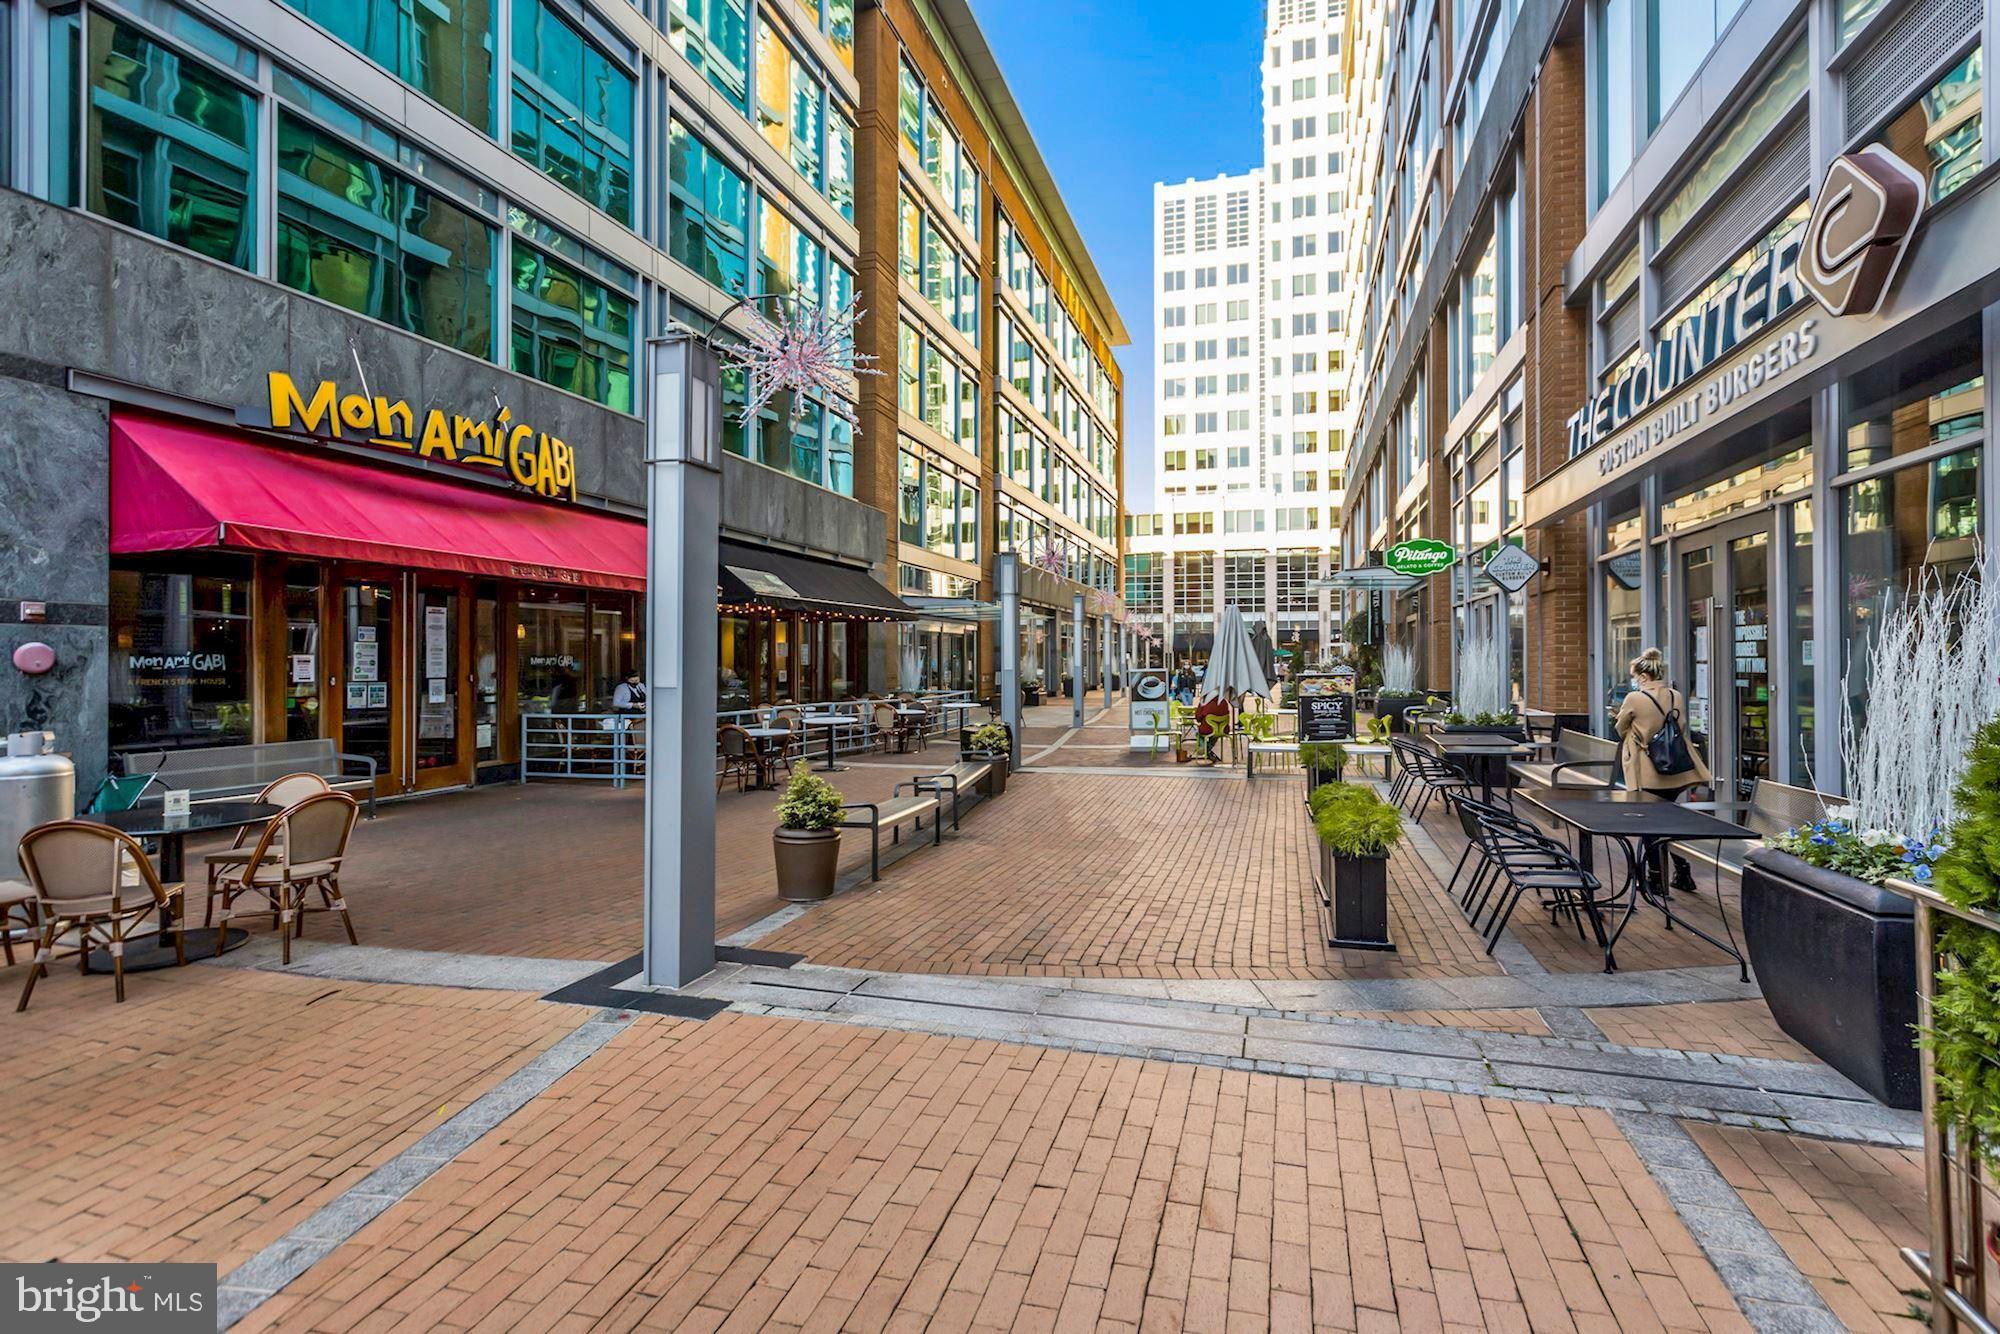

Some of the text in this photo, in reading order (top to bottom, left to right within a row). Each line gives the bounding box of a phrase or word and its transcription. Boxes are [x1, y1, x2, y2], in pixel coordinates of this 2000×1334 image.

[1567, 220, 1811, 460] THE COUNTER
[1599, 319, 1818, 477] CUSTOM BUILT BURGERS
[268, 371, 413, 444] Mon
[506, 423, 577, 503] GABI
[1394, 546, 1448, 563] Pitango
[1492, 562, 1536, 572] COUNTER
[129, 655, 163, 670] Mon
[191, 653, 226, 671] GABI
[135, 678, 169, 686] FRENCH
[170, 678, 198, 686] STEAK
